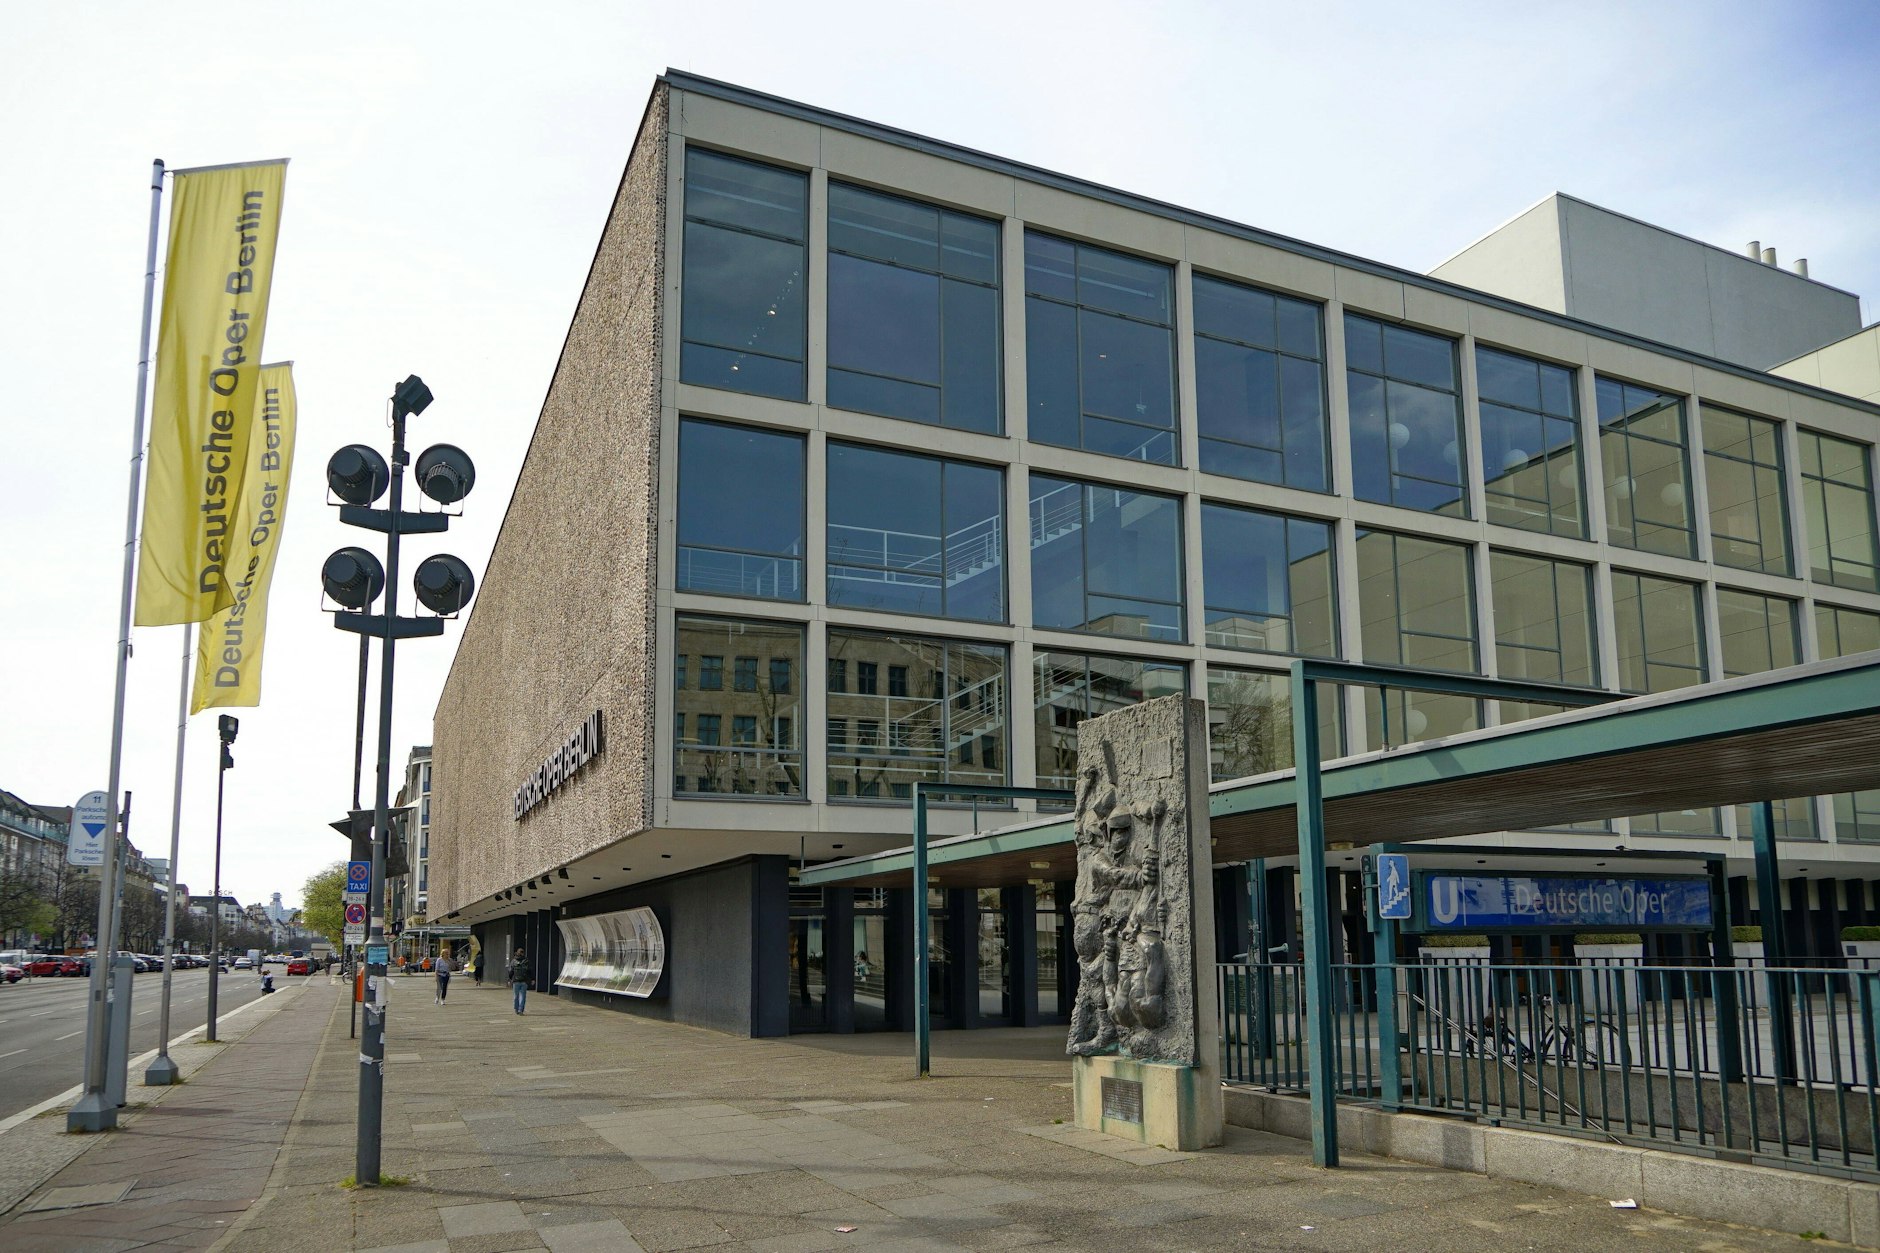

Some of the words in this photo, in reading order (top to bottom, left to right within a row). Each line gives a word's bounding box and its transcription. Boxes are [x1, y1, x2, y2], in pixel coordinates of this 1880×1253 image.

[225, 190, 264, 295] Berlin
[209, 308, 250, 397] Oper
[261, 387, 281, 472] Berlin
[200, 409, 235, 594] Deutsche
[250, 482, 280, 548] Oper
[215, 554, 260, 688] Deutsche
[543, 746, 565, 797] OPER
[564, 709, 603, 780] BERLIN
[349, 883, 368, 891] TAXI
[1431, 880, 1459, 924] U
[1515, 883, 1614, 915] Deutsche
[1620, 885, 1668, 922] Oper
